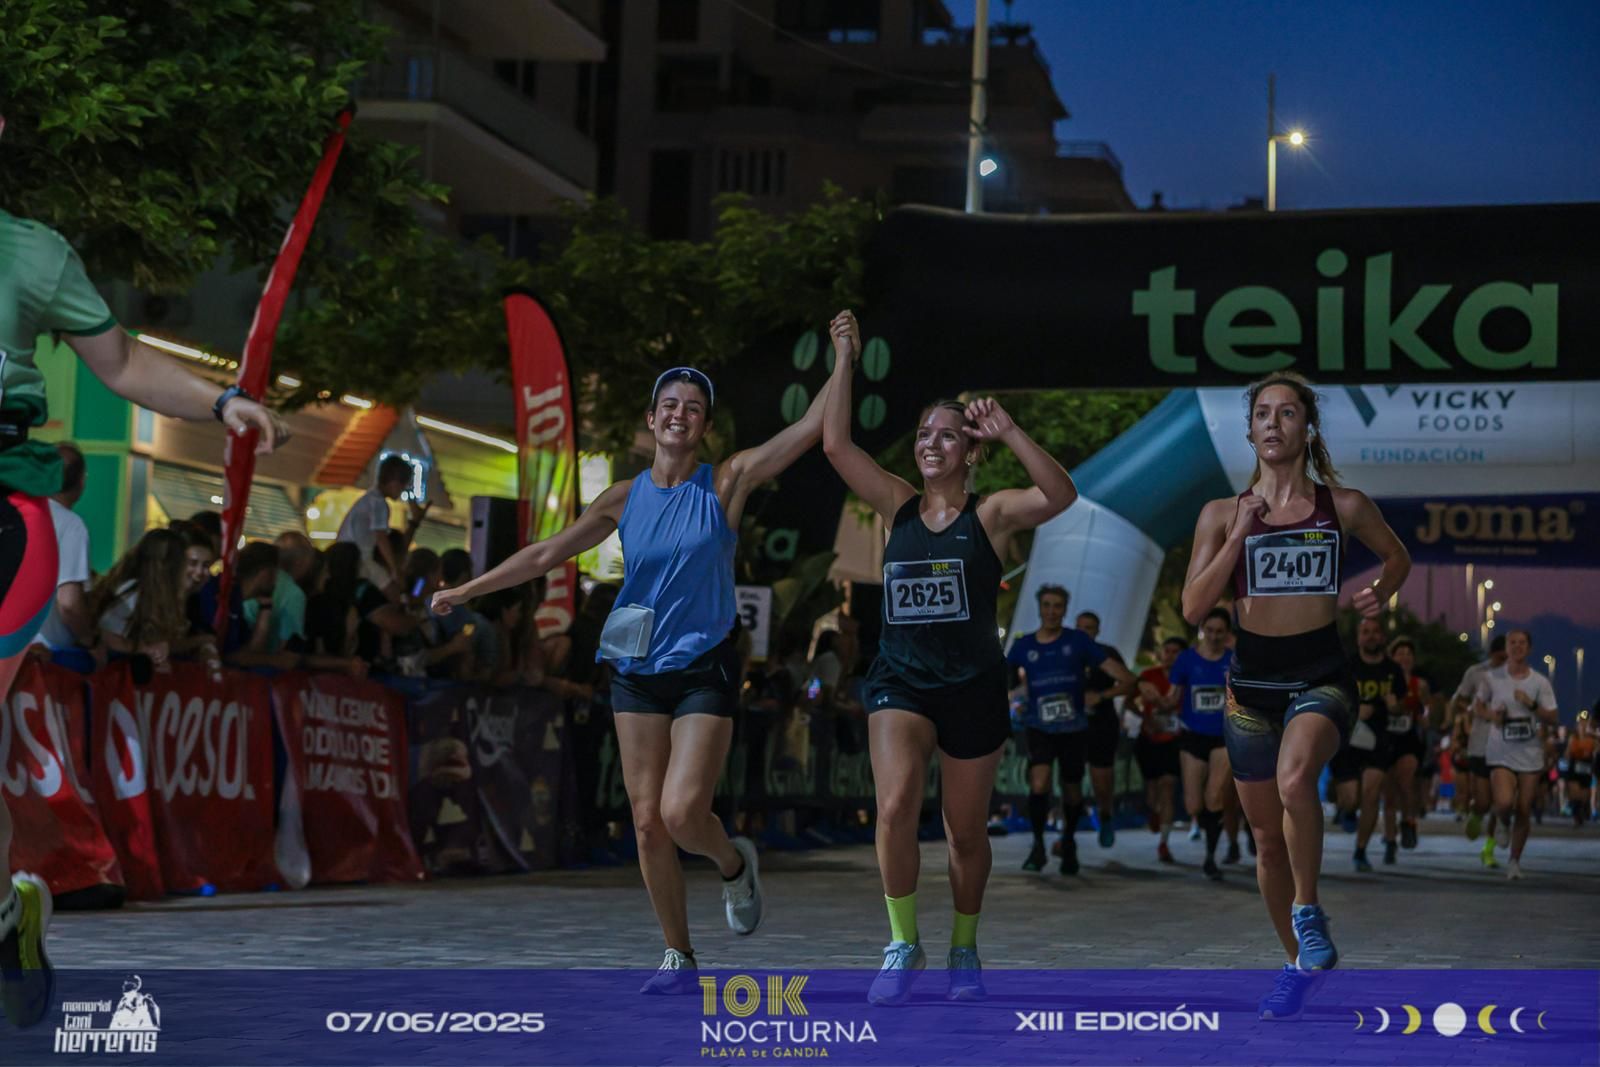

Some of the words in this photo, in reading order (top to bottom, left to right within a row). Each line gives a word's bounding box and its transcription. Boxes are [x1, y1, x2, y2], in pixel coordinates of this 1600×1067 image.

[1132, 248, 1559, 373] teika
[1411, 389, 1516, 410] VICKY
[1418, 414, 1504, 432] FOODS
[1360, 444, 1485, 464] FUNDACIÓN
[1260, 551, 1327, 579] 2407
[896, 582, 955, 609] 2625
[741, 603, 759, 632] 3
